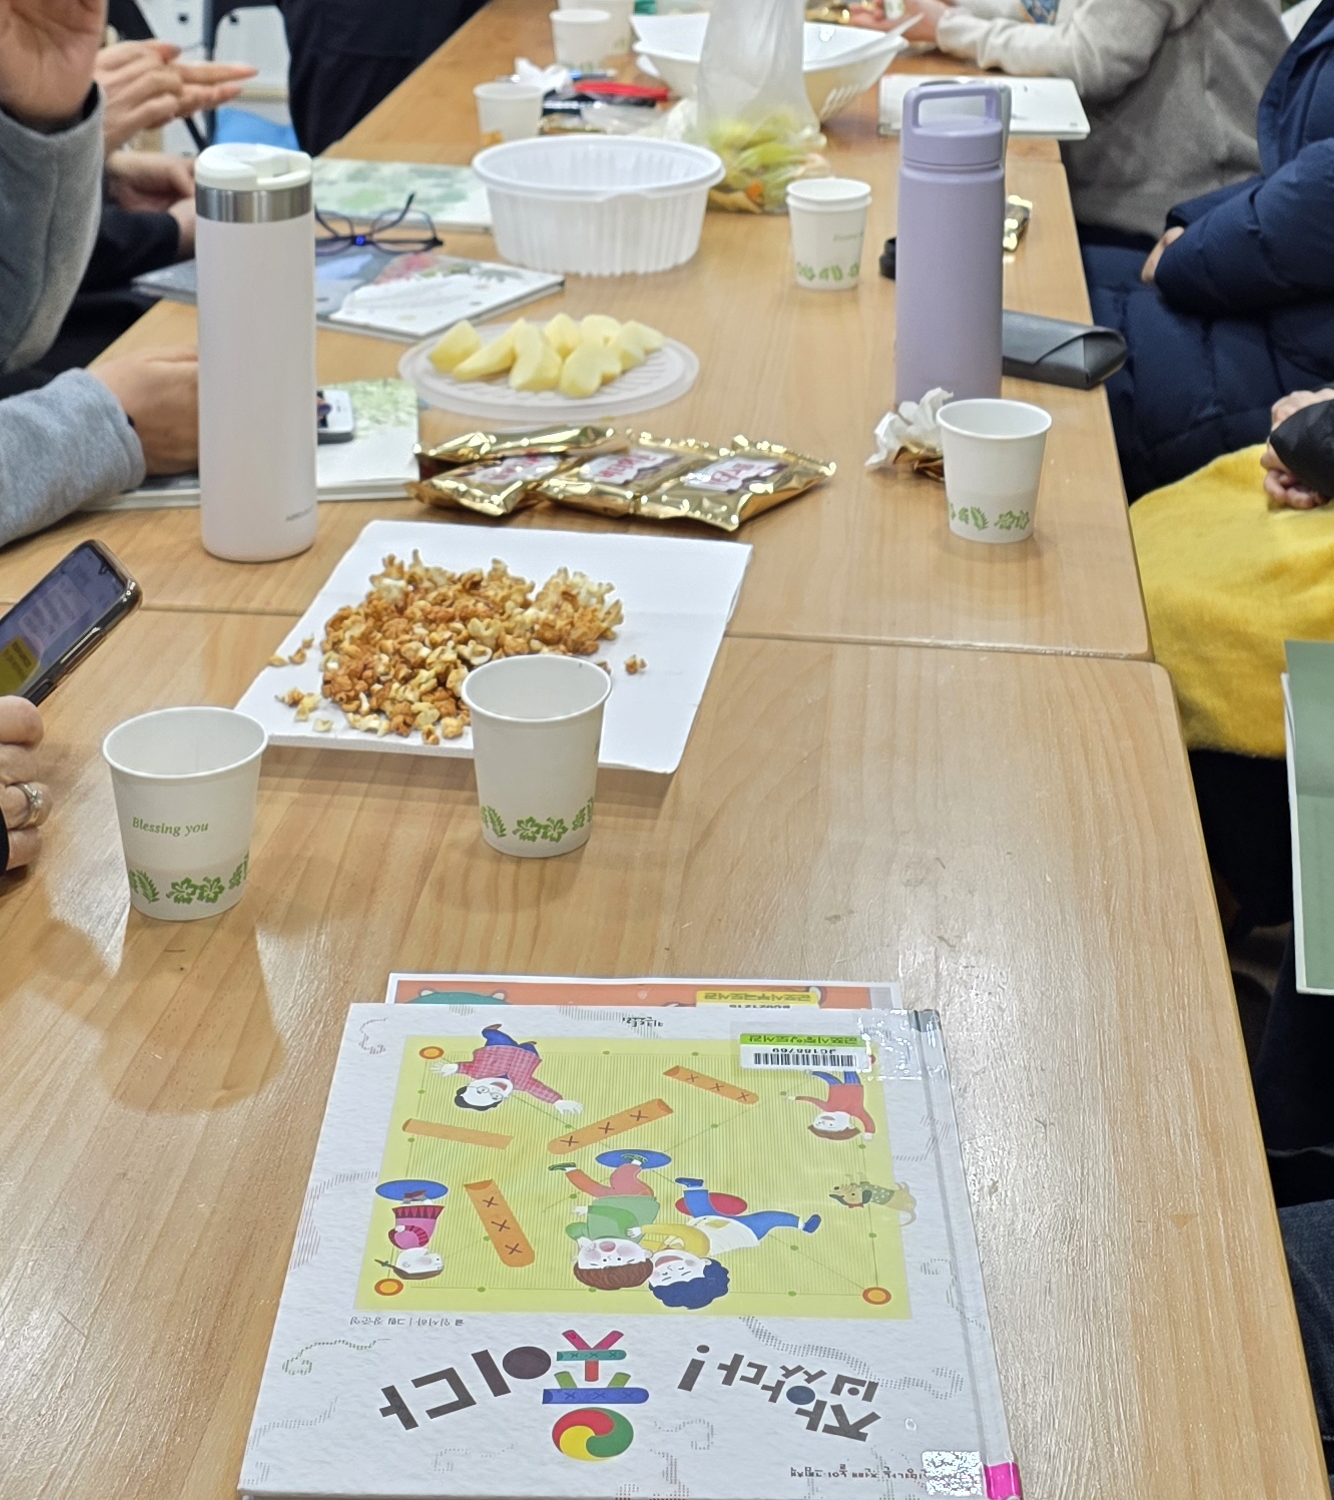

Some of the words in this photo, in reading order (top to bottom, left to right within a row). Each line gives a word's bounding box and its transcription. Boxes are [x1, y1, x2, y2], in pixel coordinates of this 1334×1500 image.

[131, 816, 180, 837] Blessing
[183, 819, 209, 835] you
[748, 1033, 859, 1045] 군포시중앙도서관
[387, 1316, 407, 1326] 그림
[378, 1328, 651, 1462] 윷이다
[677, 1343, 883, 1443] 잡았다!
[790, 1466, 824, 1478] 그림책
[827, 1463, 849, 1479] 놀이
